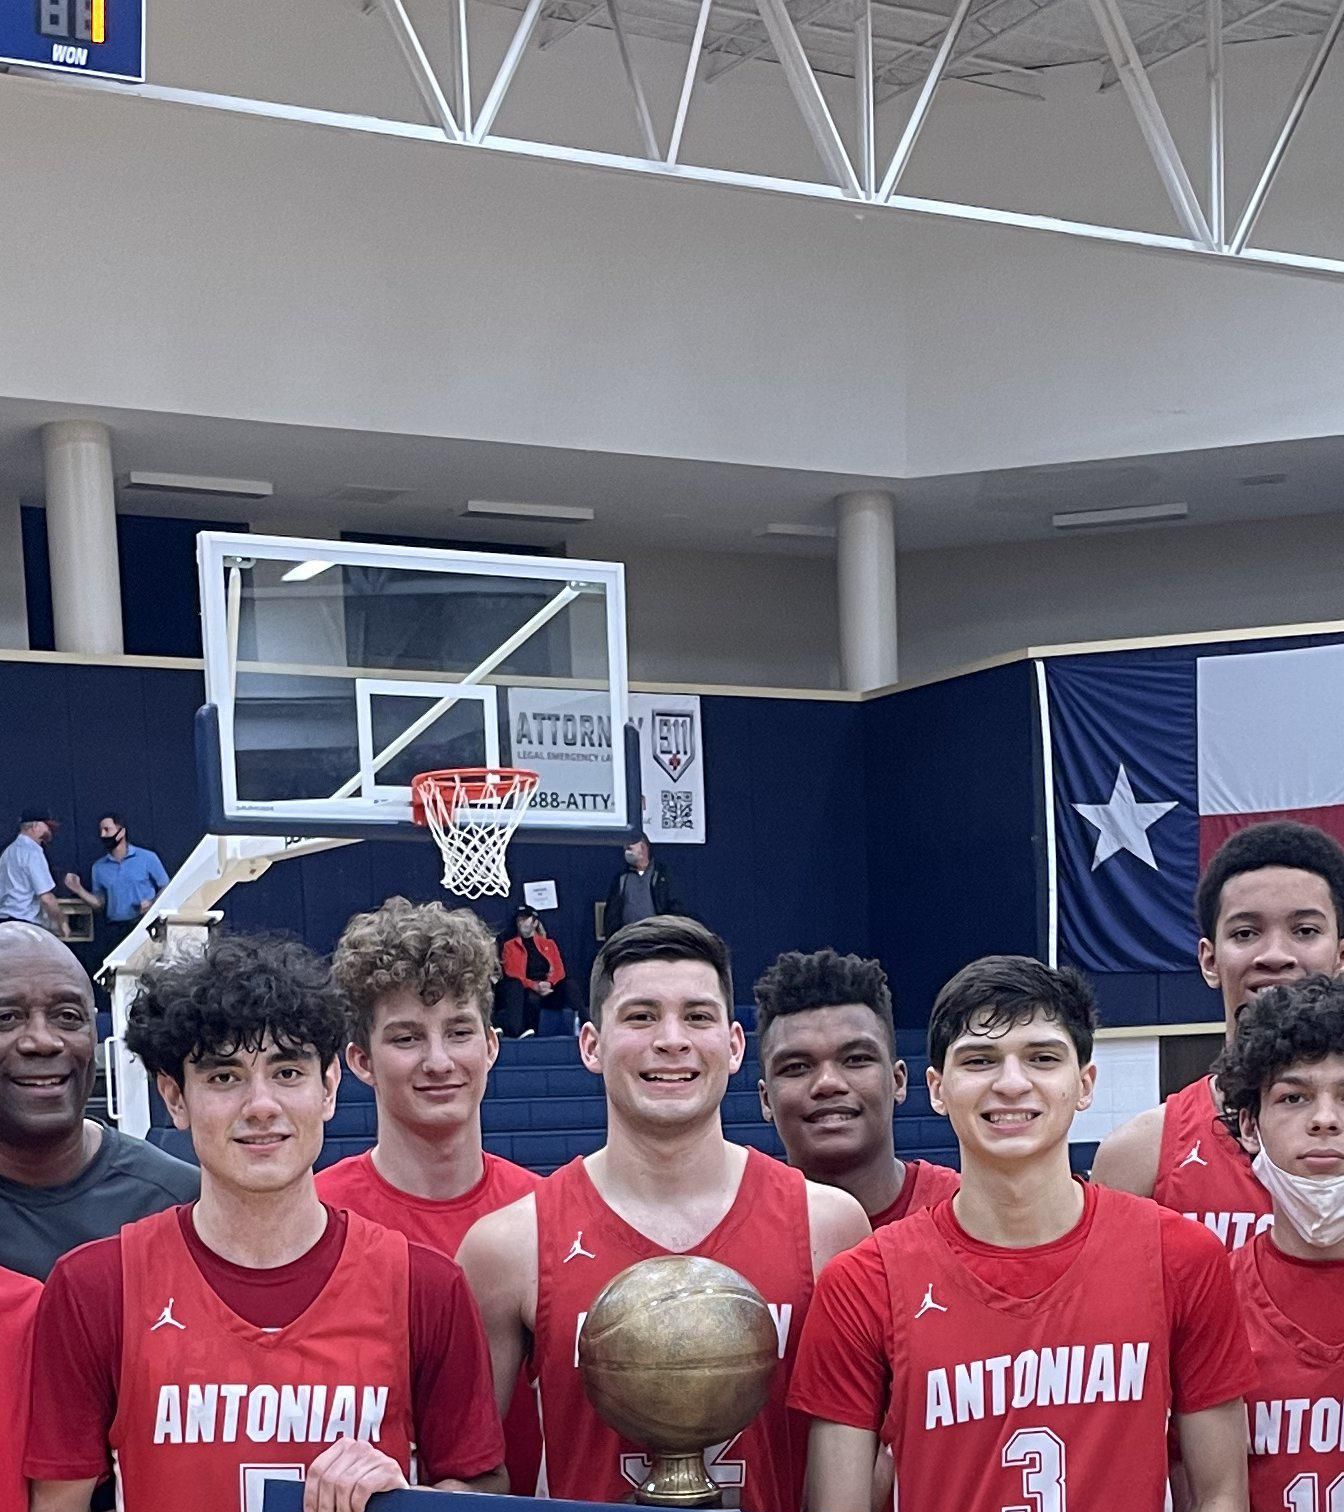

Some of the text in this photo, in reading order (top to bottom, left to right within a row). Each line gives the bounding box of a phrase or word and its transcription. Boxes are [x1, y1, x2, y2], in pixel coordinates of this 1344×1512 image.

[52, 44, 88, 65] WON
[153, 1383, 389, 1444] ANTONIAN
[925, 1342, 1150, 1431] ANTONIAN
